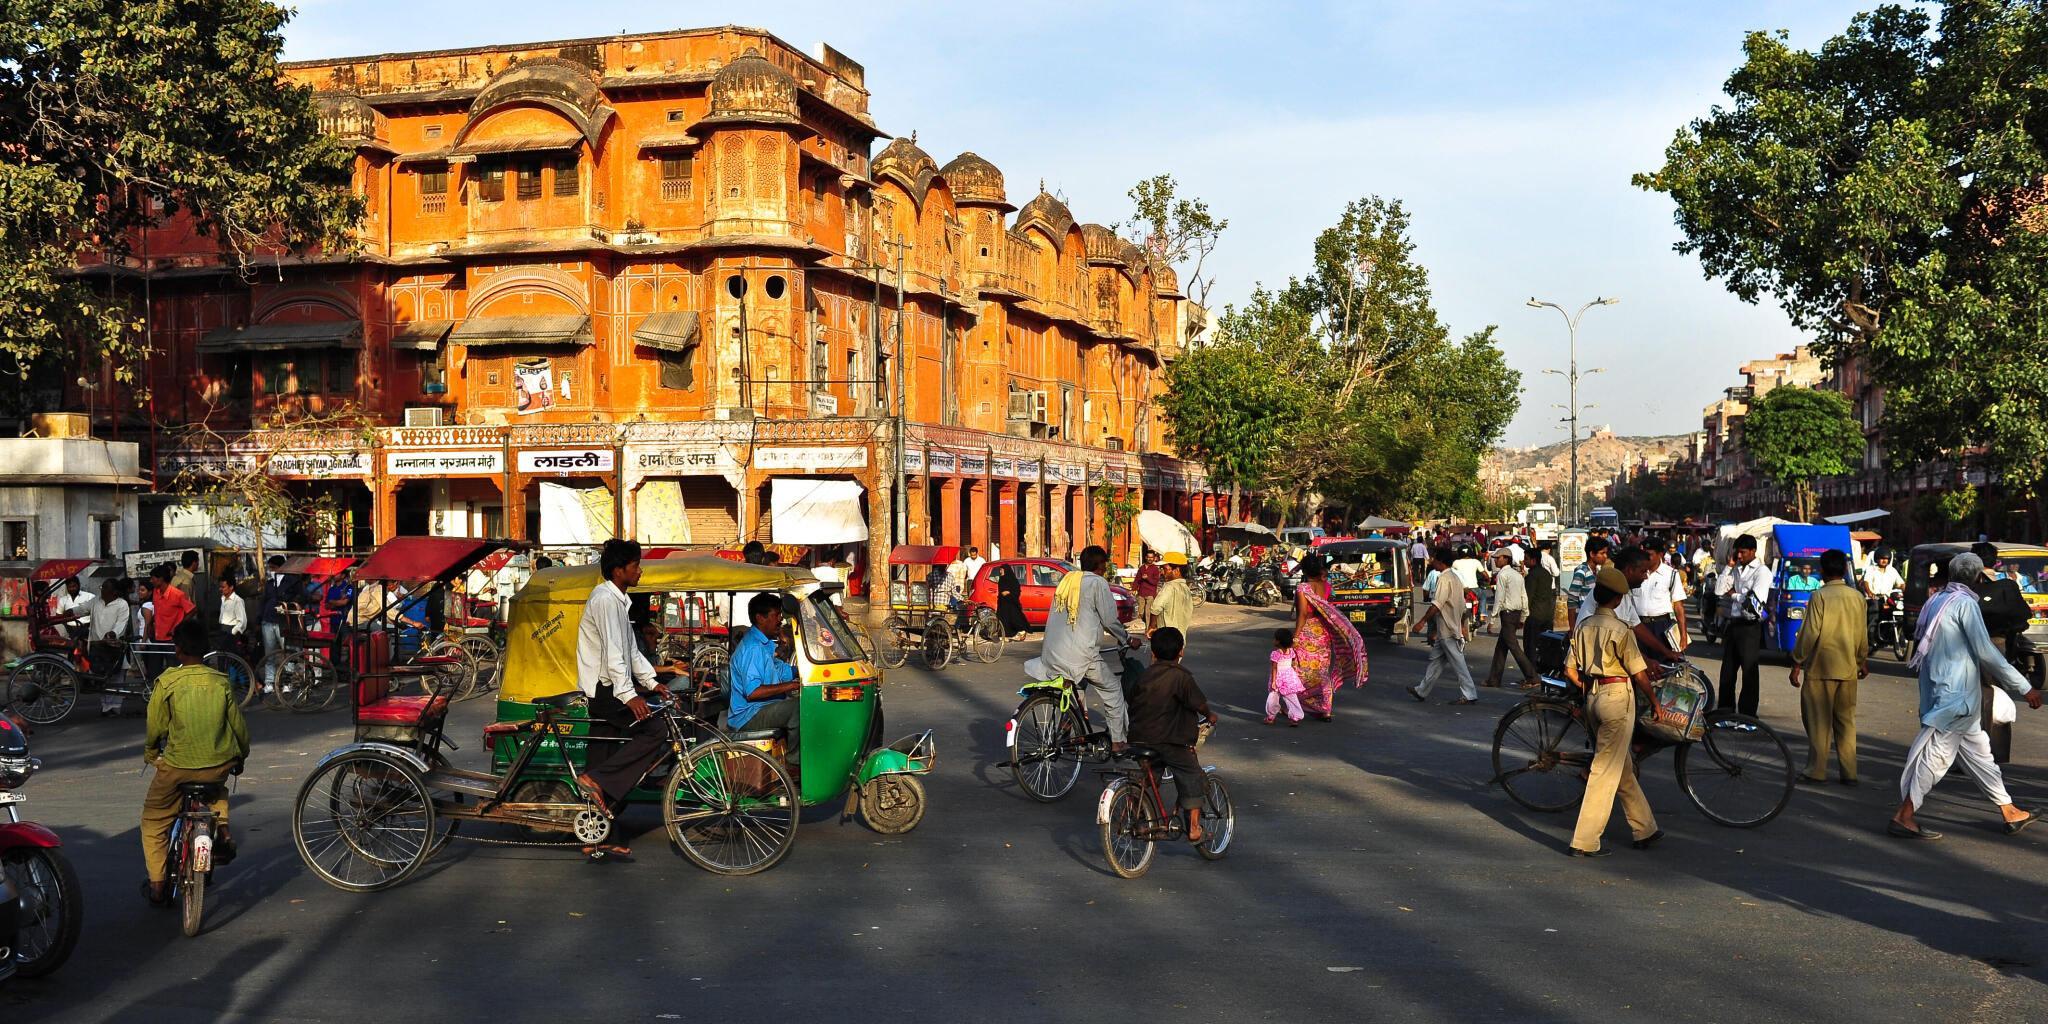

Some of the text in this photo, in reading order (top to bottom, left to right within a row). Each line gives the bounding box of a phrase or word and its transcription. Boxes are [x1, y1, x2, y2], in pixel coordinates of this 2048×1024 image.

[395, 458, 435, 468] मन्नालाल
[534, 452, 600, 468] लाडली
[639, 451, 664, 467] शर्मा
[687, 453, 716, 465] सन्स
